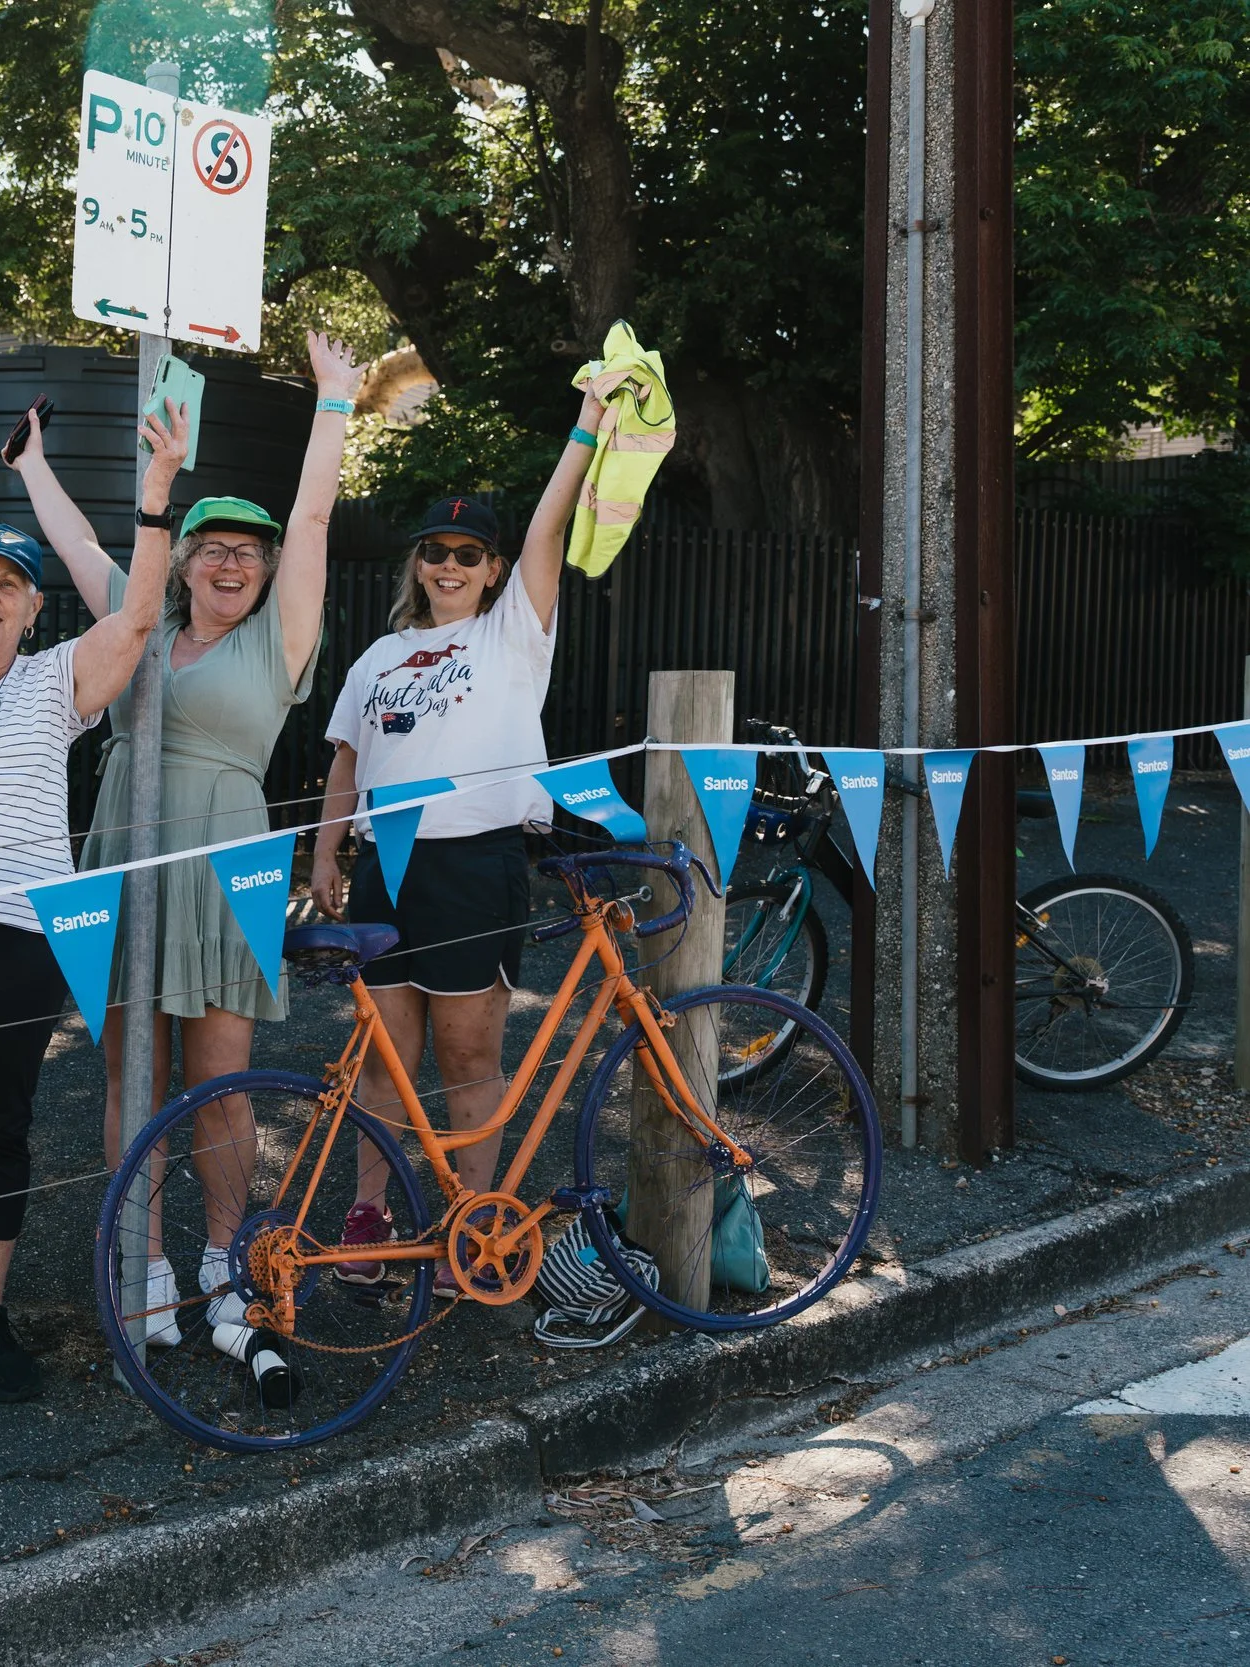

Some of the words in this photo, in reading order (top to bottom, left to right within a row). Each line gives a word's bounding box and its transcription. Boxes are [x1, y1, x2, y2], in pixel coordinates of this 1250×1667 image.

[87, 94, 123, 150] P
[134, 108, 165, 147] 10
[126, 149, 168, 172] MINUTE
[362, 659, 474, 718] Australia
[1051, 768, 1079, 782] Santos
[1137, 760, 1168, 774] Santos
[703, 776, 748, 791] Santos
[841, 775, 878, 790] Santos
[931, 770, 963, 783] Santos
[562, 787, 611, 805] Santos
[230, 868, 283, 892] Santos
[52, 909, 110, 934] Santos
